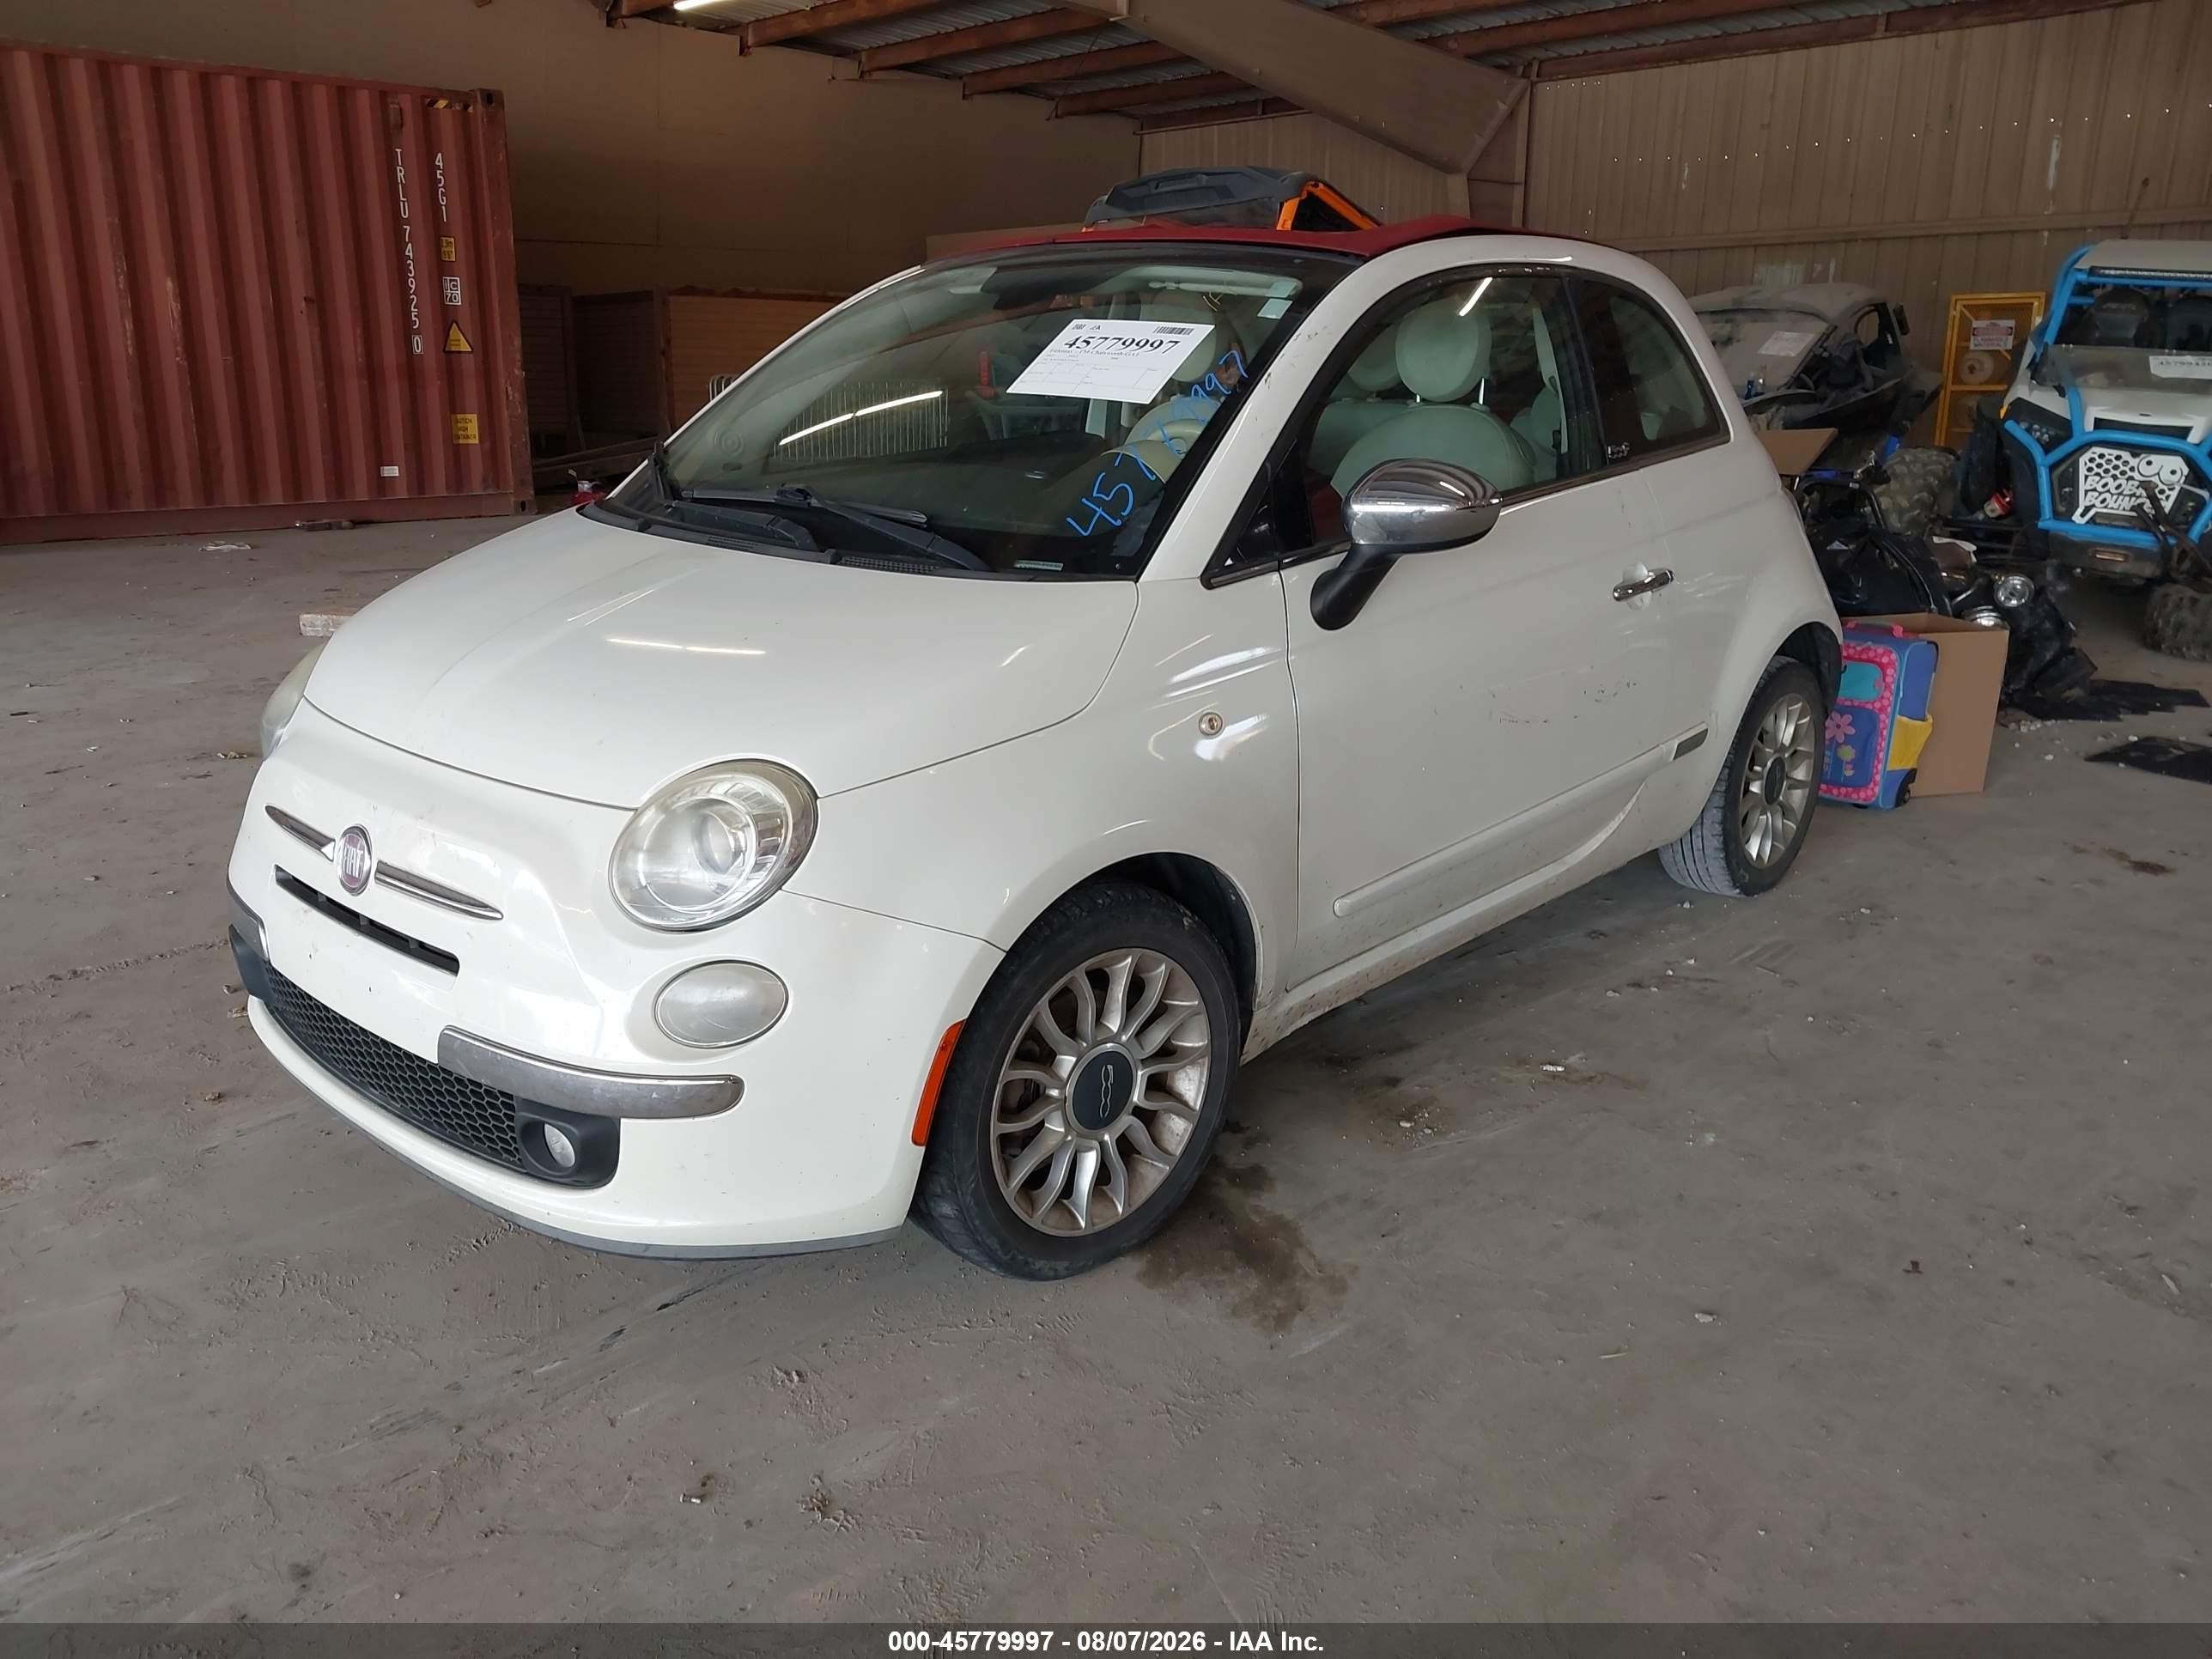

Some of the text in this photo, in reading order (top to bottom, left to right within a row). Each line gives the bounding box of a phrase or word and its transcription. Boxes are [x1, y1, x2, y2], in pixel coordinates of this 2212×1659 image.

[435, 153, 447, 222] 45G1
[395, 149, 422, 353] TRLU 743925 0
[445, 293, 459, 303] 70
[1064, 335, 1182, 355] 45779997
[343, 844, 363, 878] FIAT
[1099, 1064, 1114, 1119] 500
